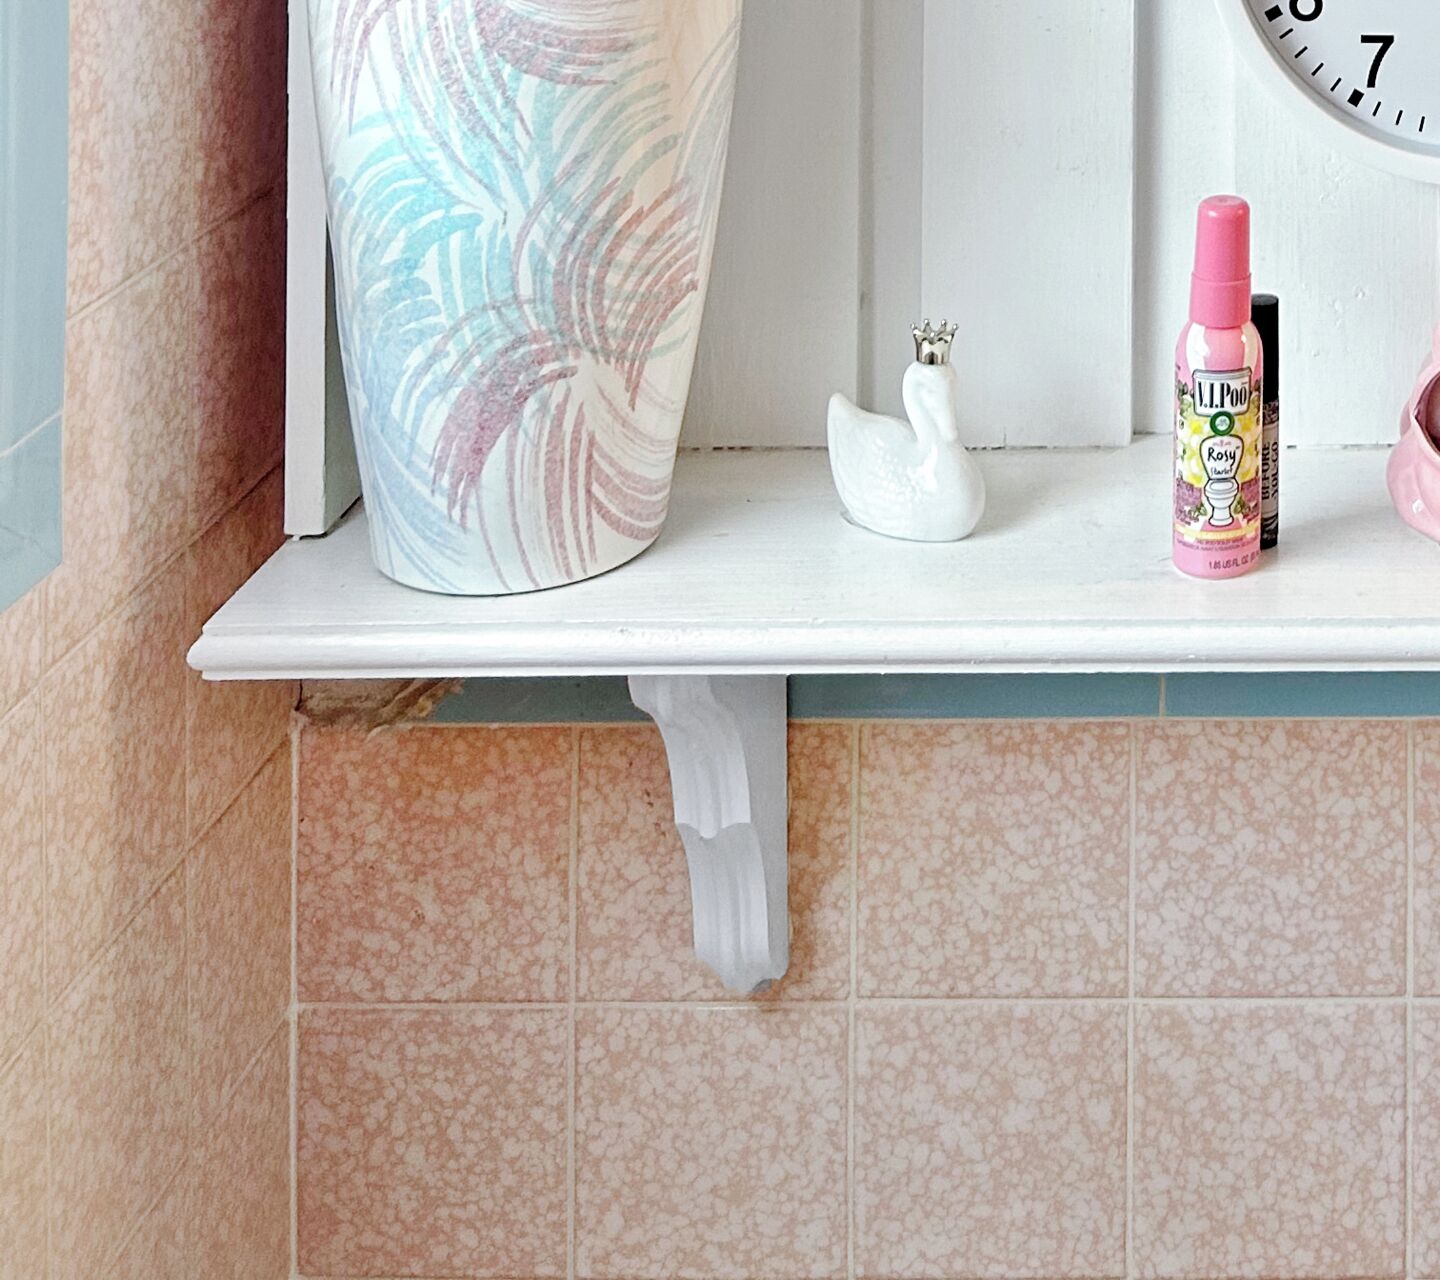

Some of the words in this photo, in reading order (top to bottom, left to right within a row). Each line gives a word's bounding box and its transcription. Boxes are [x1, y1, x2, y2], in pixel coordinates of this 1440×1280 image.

[1360, 34, 1395, 89] 7
[1198, 382, 1248, 408] V.I.Poo
[1207, 447, 1236, 468] Rosy
[1262, 441, 1270, 500] BEFORE
